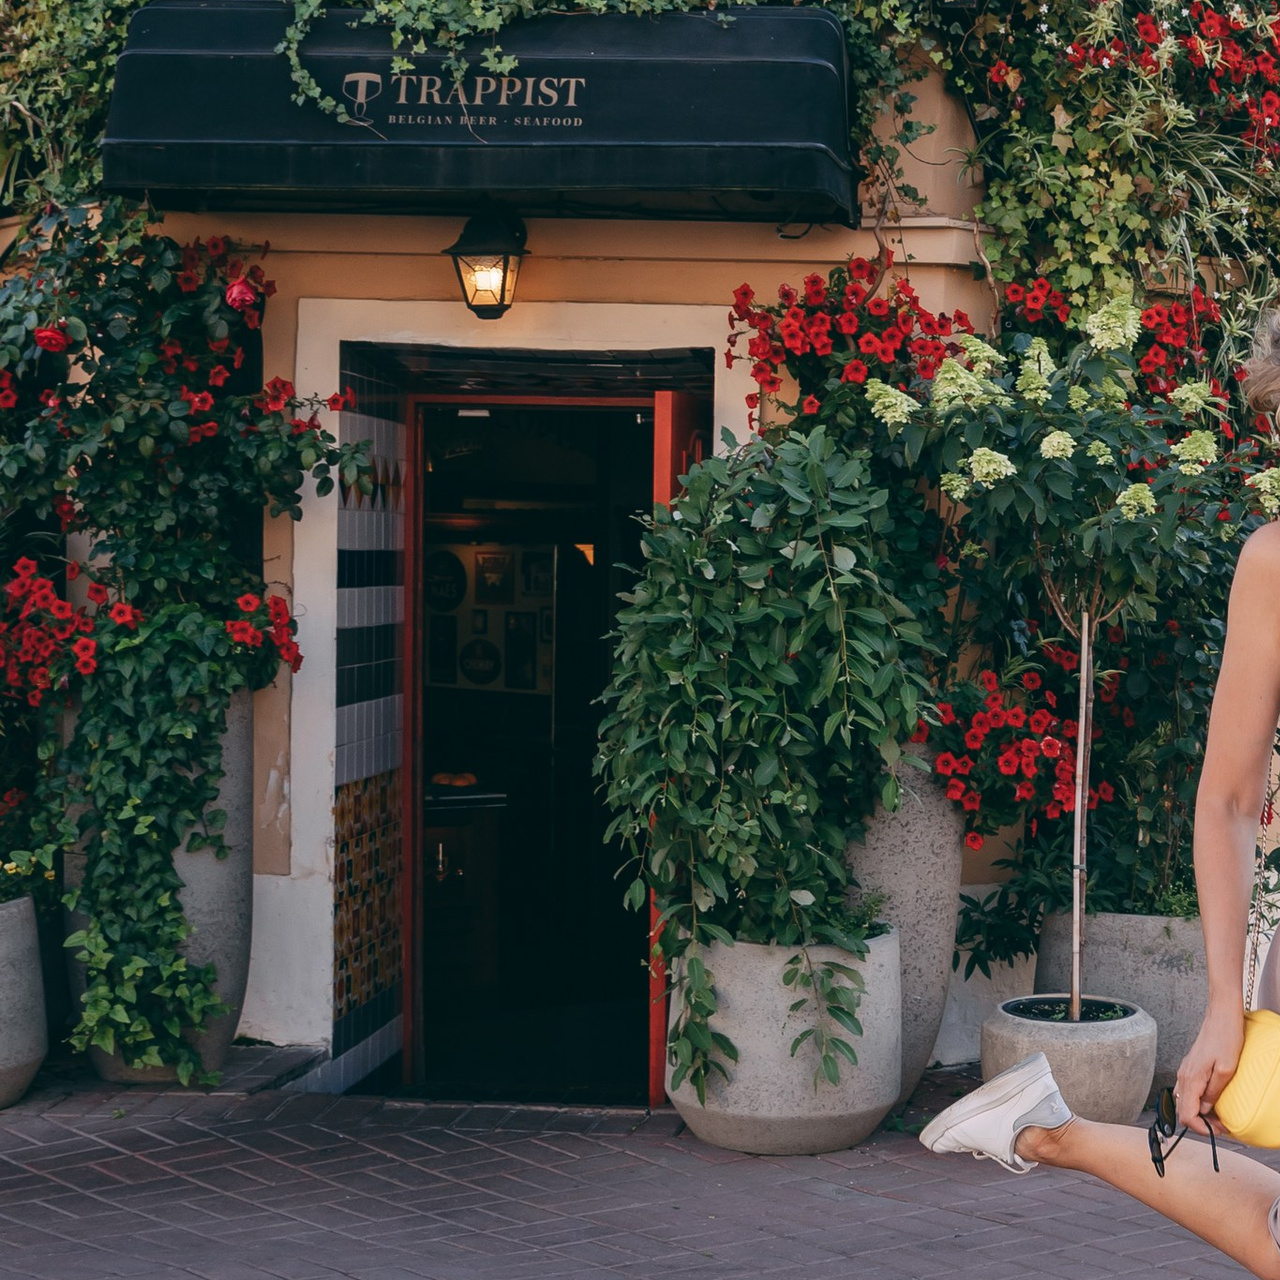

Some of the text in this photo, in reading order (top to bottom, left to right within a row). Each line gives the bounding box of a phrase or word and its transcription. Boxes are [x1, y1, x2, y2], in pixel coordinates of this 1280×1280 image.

[391, 75, 586, 108] TRAPPIST
[388, 114, 584, 127] BELGIAN BEER SEAFOOD
